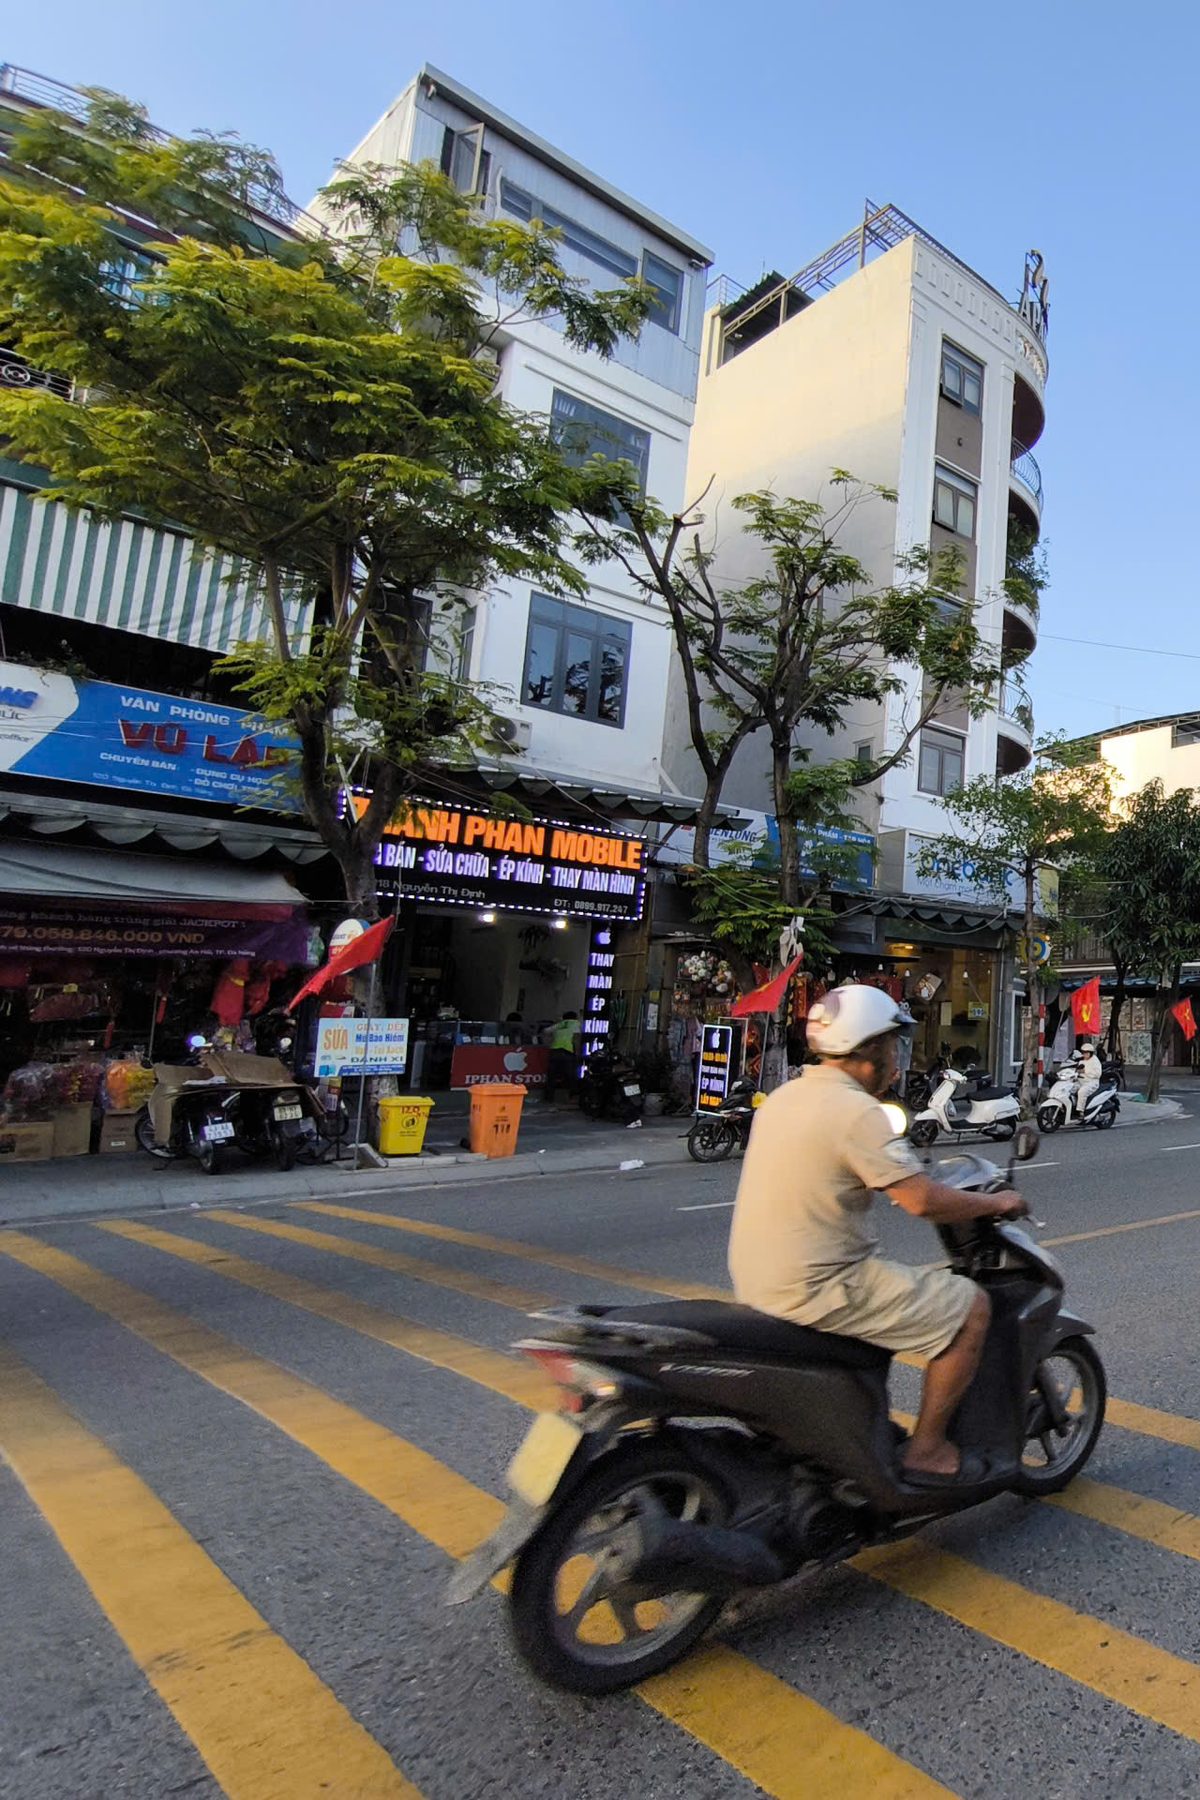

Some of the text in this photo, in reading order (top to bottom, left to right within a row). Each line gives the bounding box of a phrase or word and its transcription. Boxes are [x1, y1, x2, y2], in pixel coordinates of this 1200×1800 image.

[120, 694, 160, 713] VĂN
[169, 705, 230, 726] PHÒNG
[463, 814, 545, 855] PHAN
[550, 829, 642, 869] MOBILE
[384, 841, 416, 869] BÁN
[424, 843, 453, 874] SỬA
[455, 852, 490, 878] CHỮA
[498, 855, 516, 881] ÉP
[516, 858, 545, 884] KÍNH
[552, 866, 582, 889] THAY
[582, 867, 610, 892] MÀN
[609, 870, 636, 895] HÌNH
[393, 880, 438, 894] Nguyễn
[440, 886, 458, 896] Thị
[461, 888, 486, 899] Định
[590, 952, 615, 967] THAY
[588, 972, 613, 989] MÀN
[591, 995, 606, 1012] ÉP
[584, 1017, 609, 1033] KÍNH
